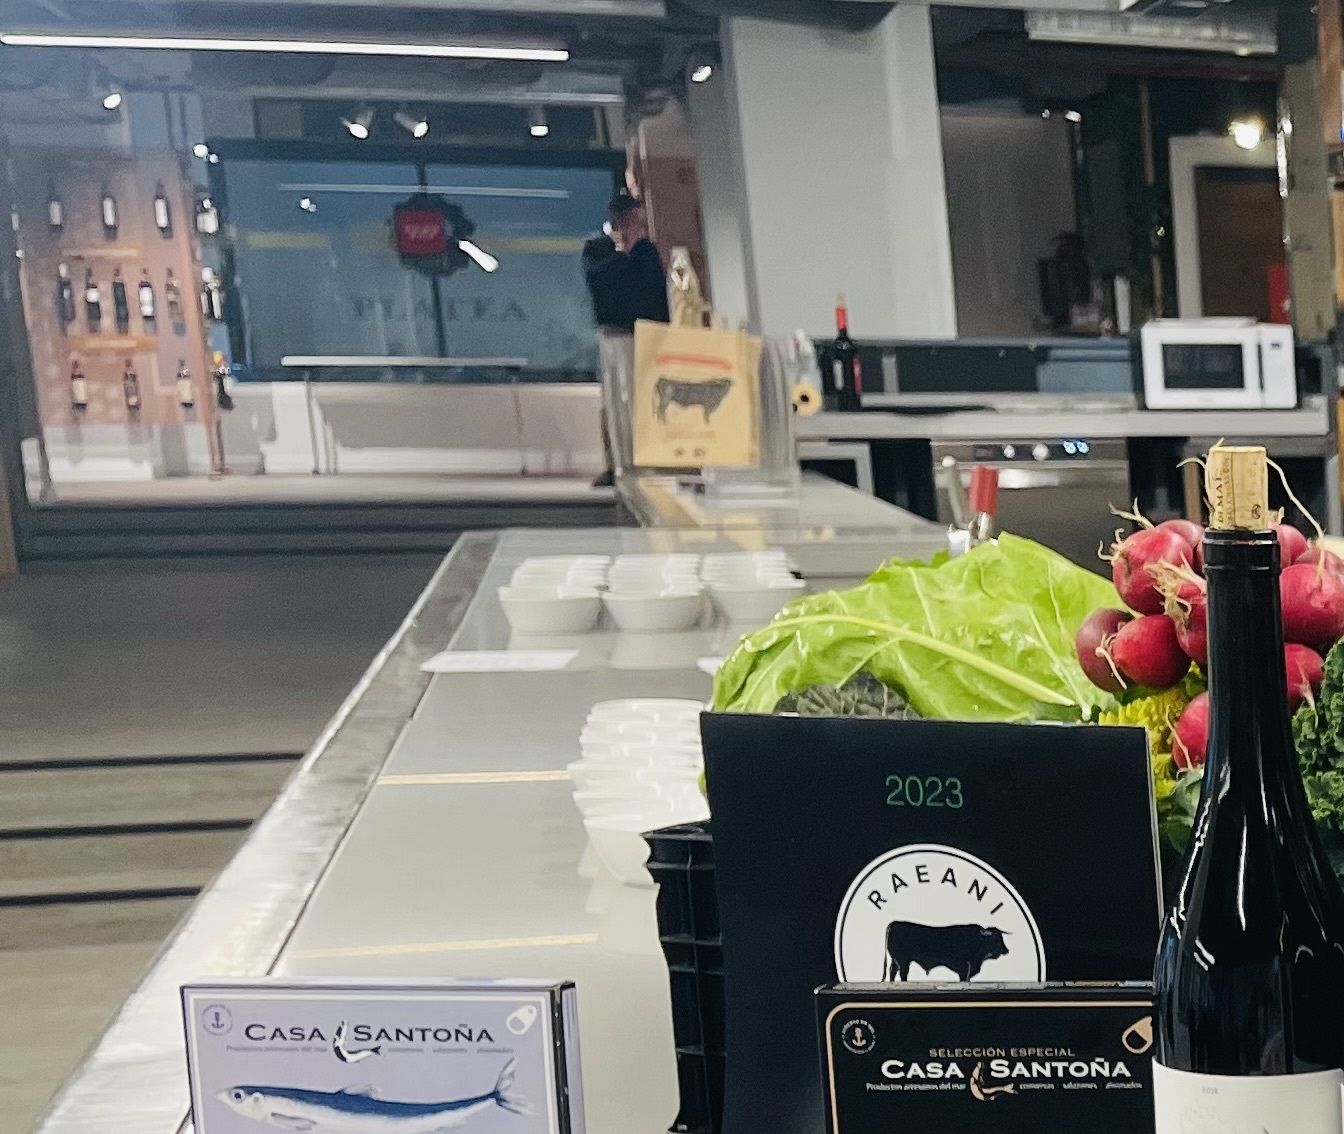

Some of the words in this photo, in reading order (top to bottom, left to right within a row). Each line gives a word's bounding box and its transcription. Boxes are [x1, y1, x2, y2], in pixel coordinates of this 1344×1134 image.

[885, 775, 964, 809] 2023
[867, 864, 1005, 916] RAEANI
[245, 1023, 326, 1042] CASA
[353, 1023, 494, 1042] SANTOÑA
[929, 1047, 1006, 1058] SELECCIÓN
[1010, 1048, 1076, 1058] ESPECIAL
[881, 1059, 965, 1079] CASA
[990, 1057, 1132, 1079] SANTOÑA
